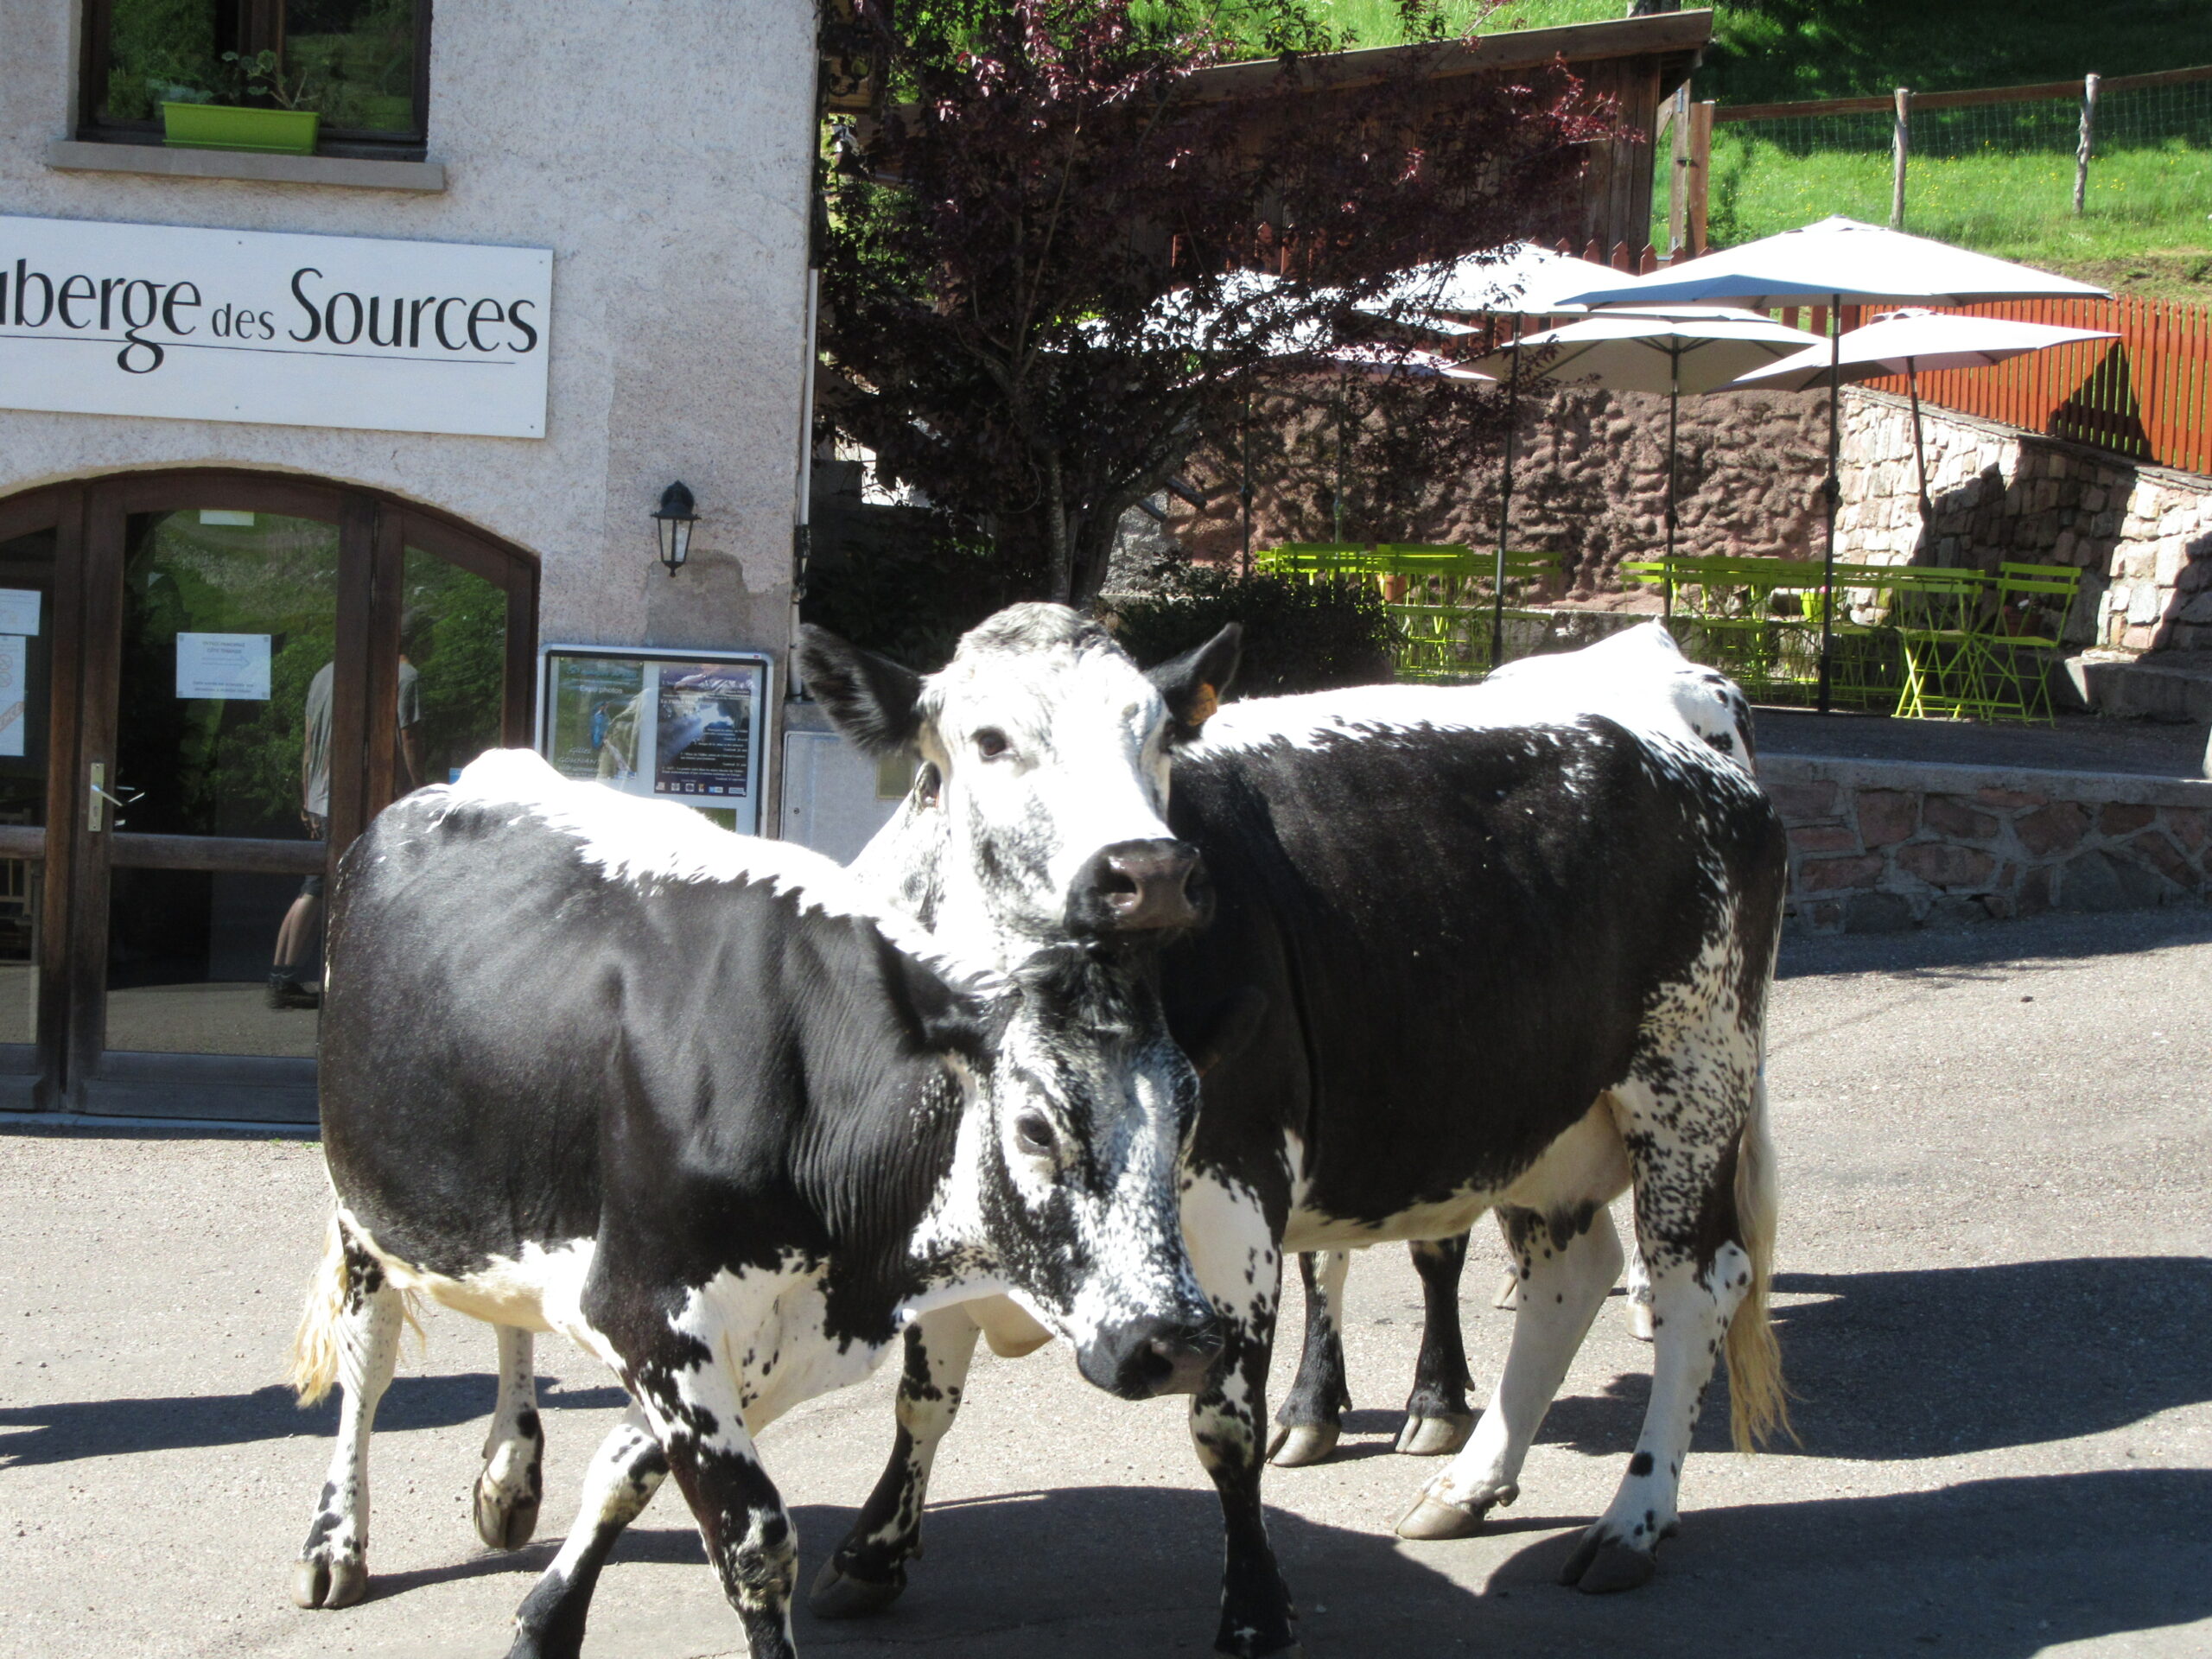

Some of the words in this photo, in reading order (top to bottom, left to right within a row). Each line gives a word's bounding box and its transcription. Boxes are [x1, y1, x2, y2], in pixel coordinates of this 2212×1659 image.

[0, 258, 202, 373] berge
[211, 303, 275, 340] des
[288, 267, 538, 353] Sources
